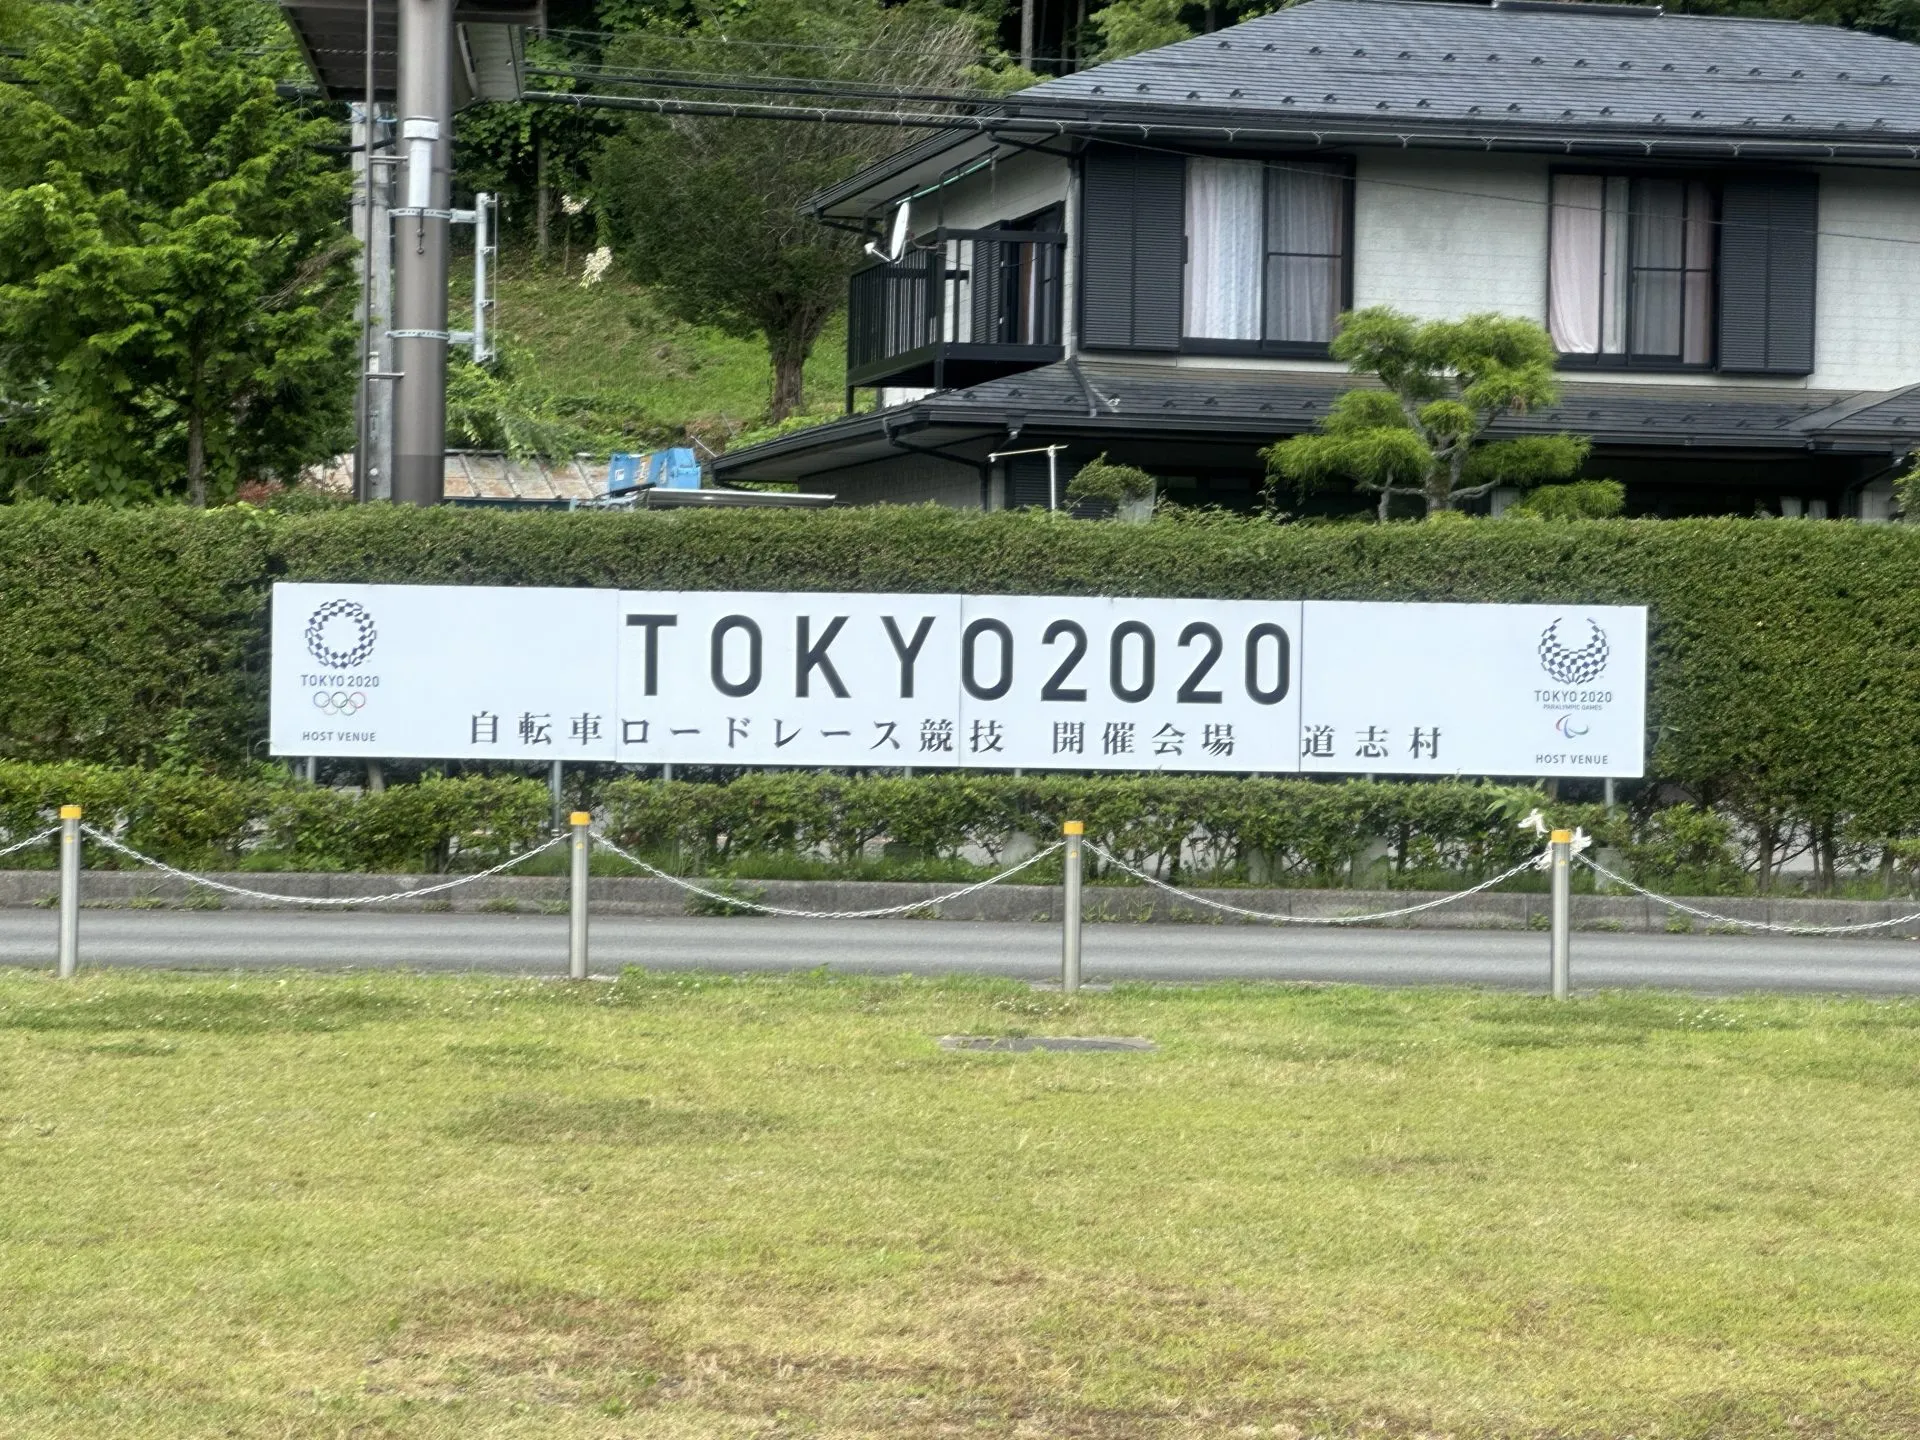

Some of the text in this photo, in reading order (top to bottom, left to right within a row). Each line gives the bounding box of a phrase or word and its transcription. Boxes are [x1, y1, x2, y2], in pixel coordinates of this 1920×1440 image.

[301, 674, 380, 688] TOKYO 2020
[1534, 690, 1612, 703] TOKYO 2020
[302, 731, 376, 742] HOST VENUE
[471, 710, 1441, 760] 自転車ロードレース競技 開催会場 道志村
[1535, 754, 1608, 765] HOST VENUE
